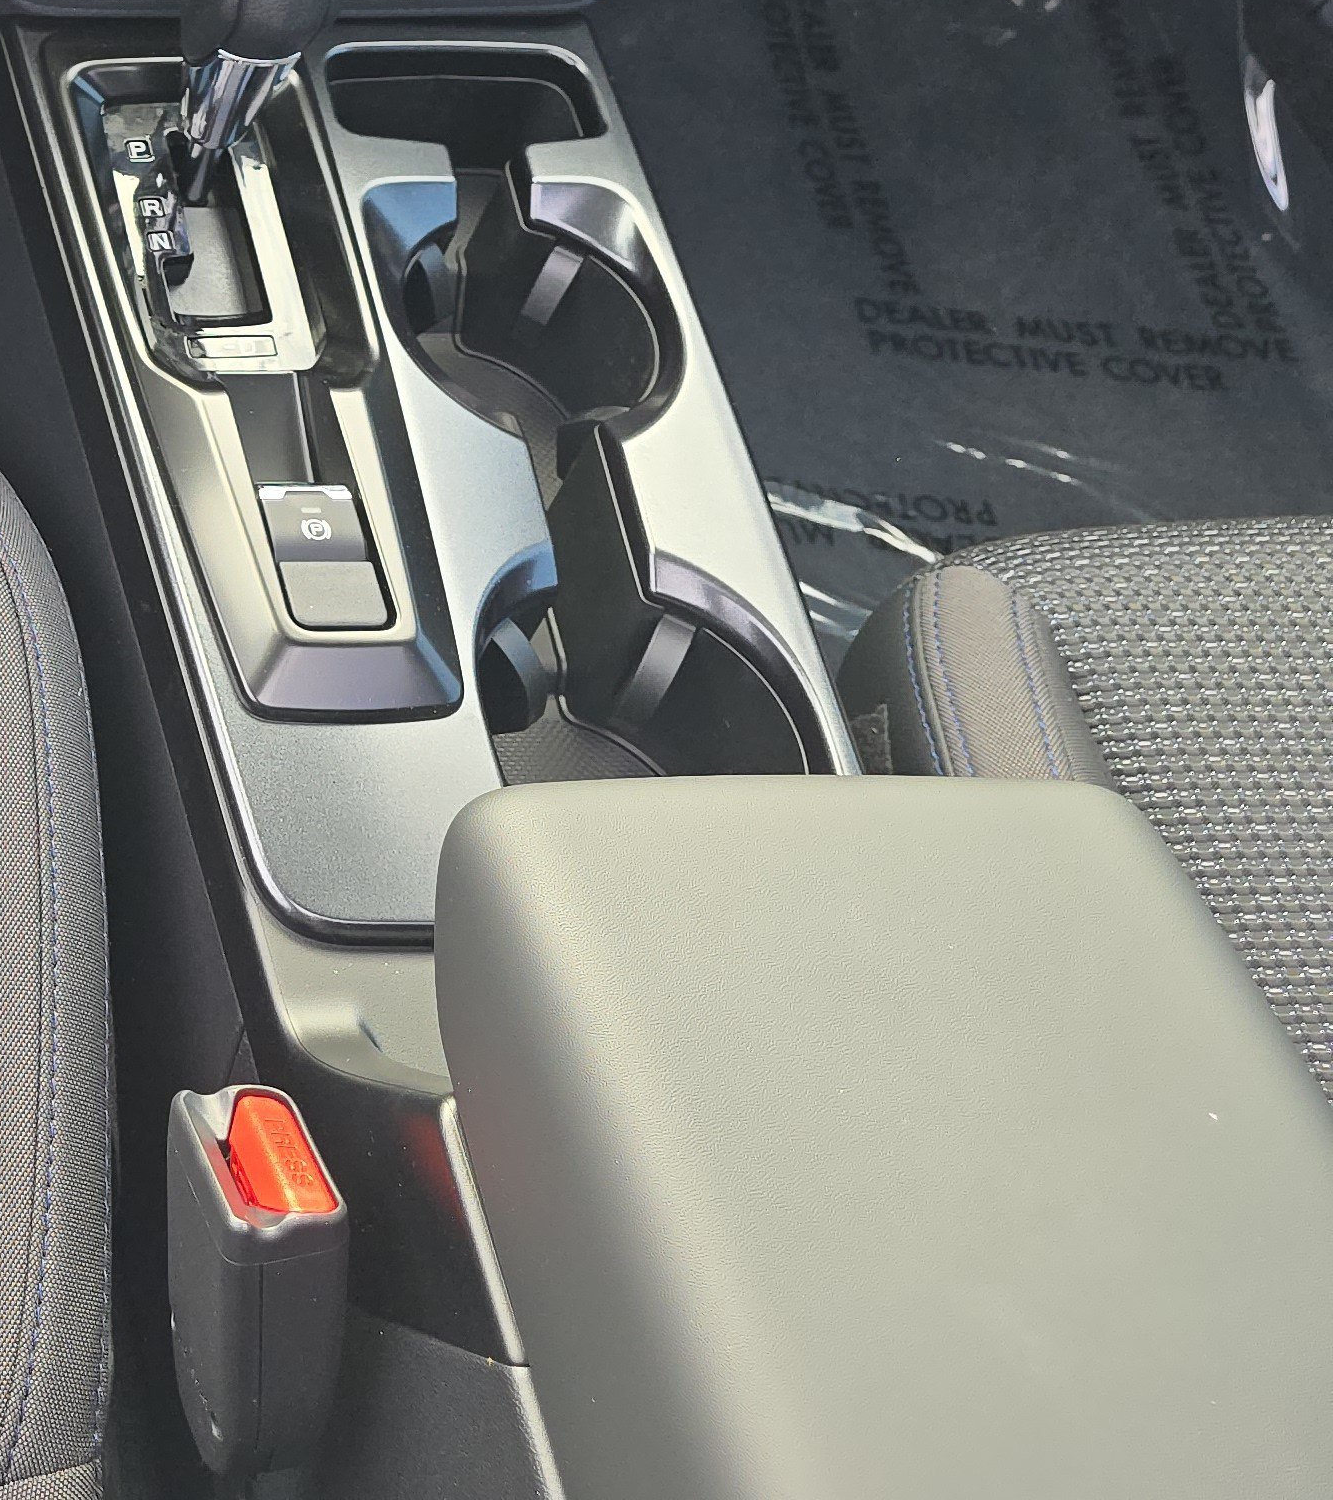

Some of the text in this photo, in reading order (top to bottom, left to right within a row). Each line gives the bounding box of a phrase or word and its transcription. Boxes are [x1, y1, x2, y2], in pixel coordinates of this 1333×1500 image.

[128, 141, 148, 160] P
[143, 199, 164, 217] R
[150, 232, 170, 250] N
[855, 297, 1300, 362] DEALER MUST REMOVE
[866, 330, 1228, 391] PROTECTIVE COVER
